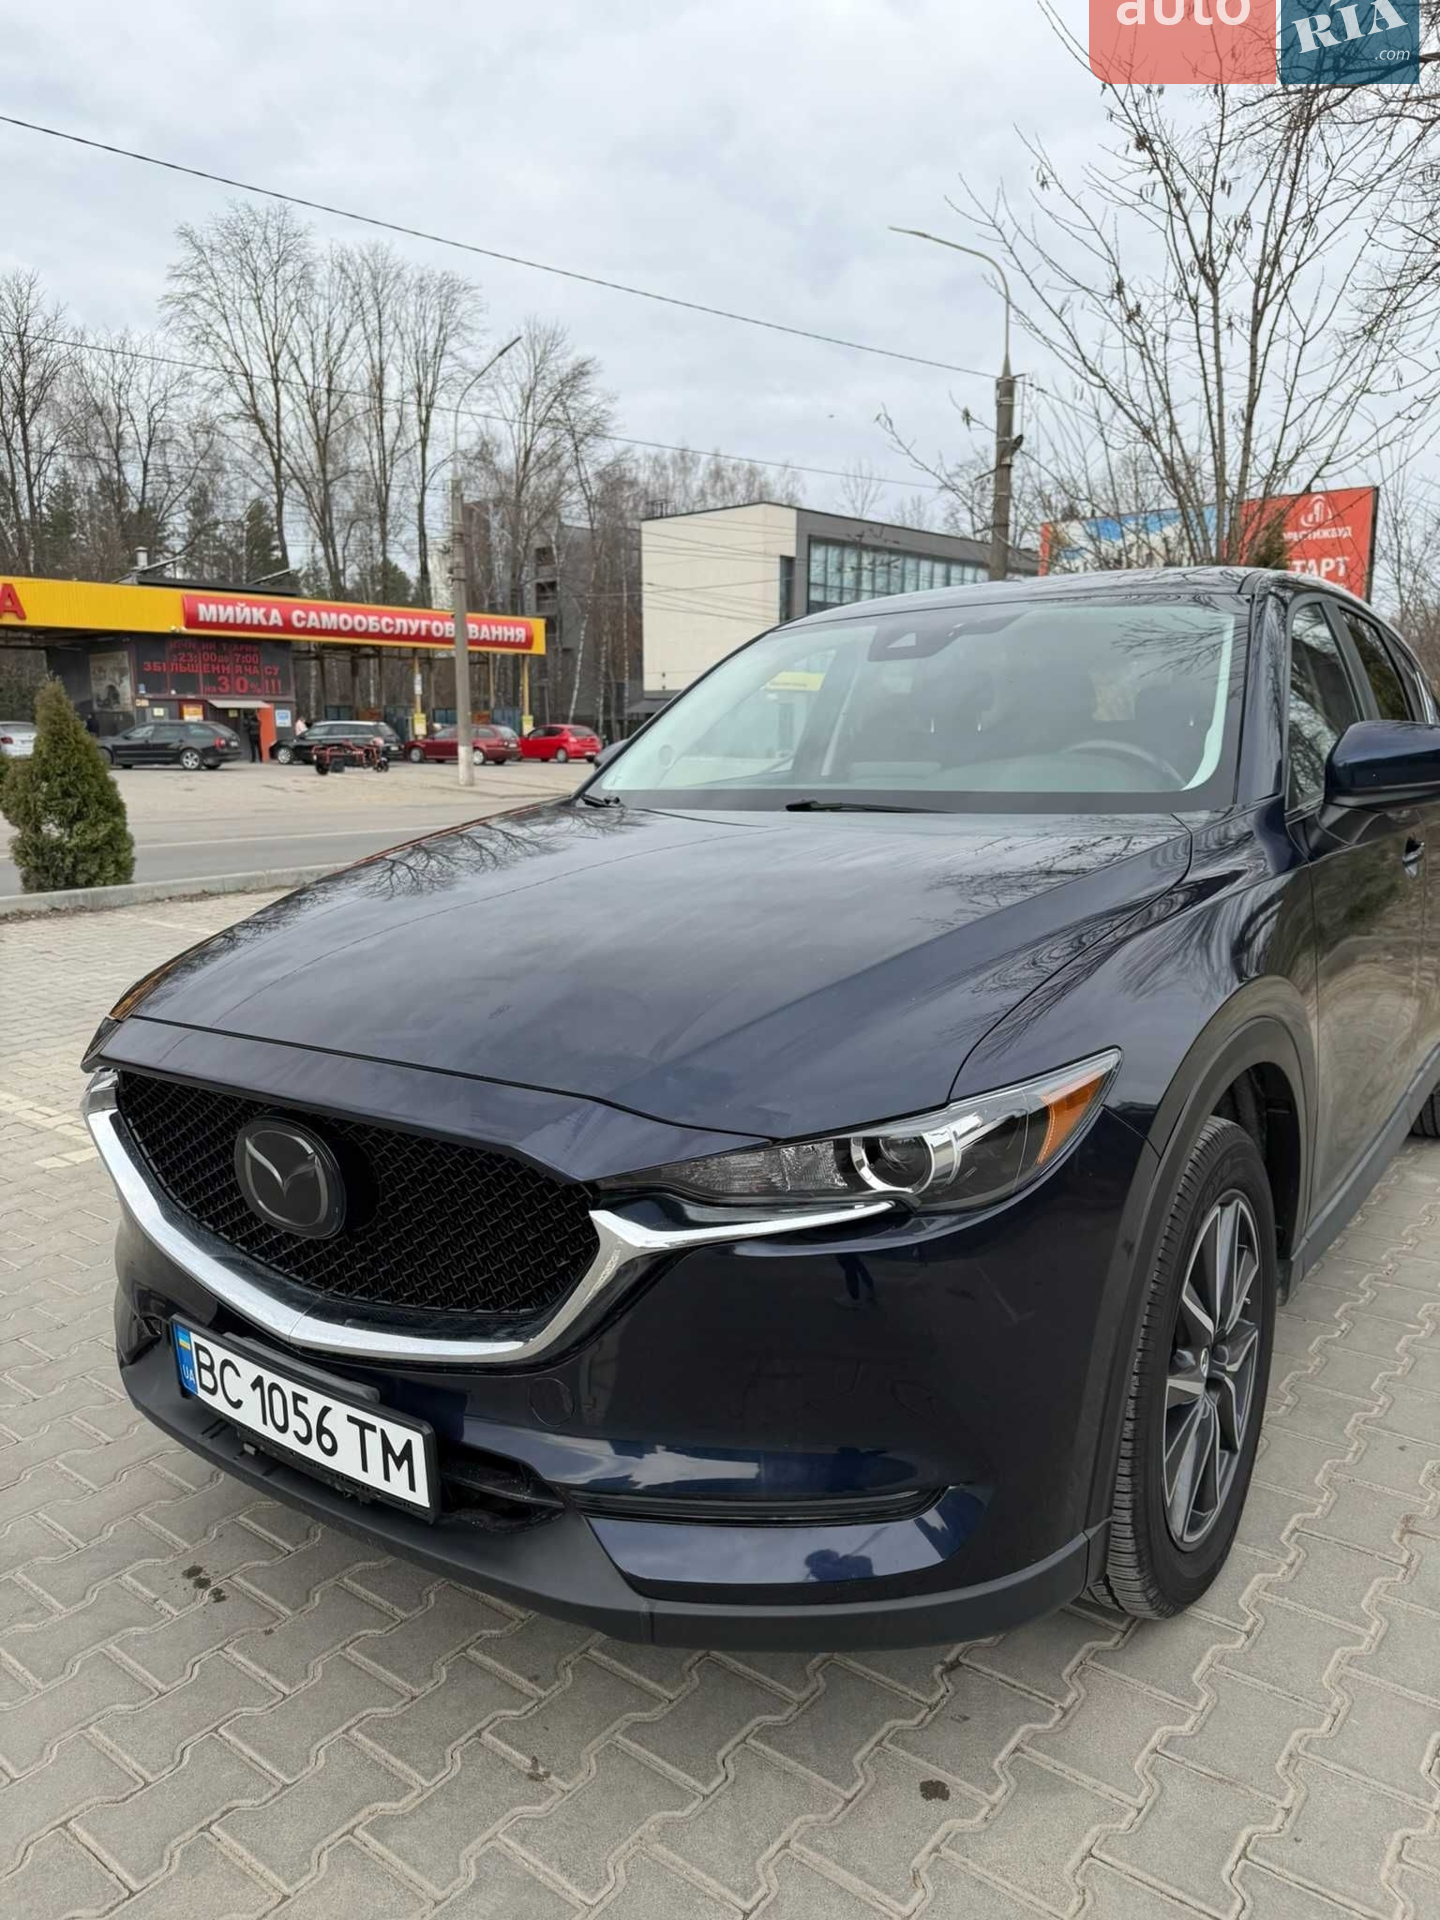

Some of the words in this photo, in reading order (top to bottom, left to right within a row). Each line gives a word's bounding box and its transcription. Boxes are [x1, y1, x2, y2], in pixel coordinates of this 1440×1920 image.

[1287, 556, 1350, 577] ТАРТ
[197, 602, 284, 627] МИЙКА
[291, 609, 526, 643] САМООБСЛУГОВВАННЯ
[182, 1364, 196, 1384] UA
[194, 1341, 243, 1409] BC
[250, 1375, 338, 1457] 1056
[346, 1414, 416, 1493] TM
